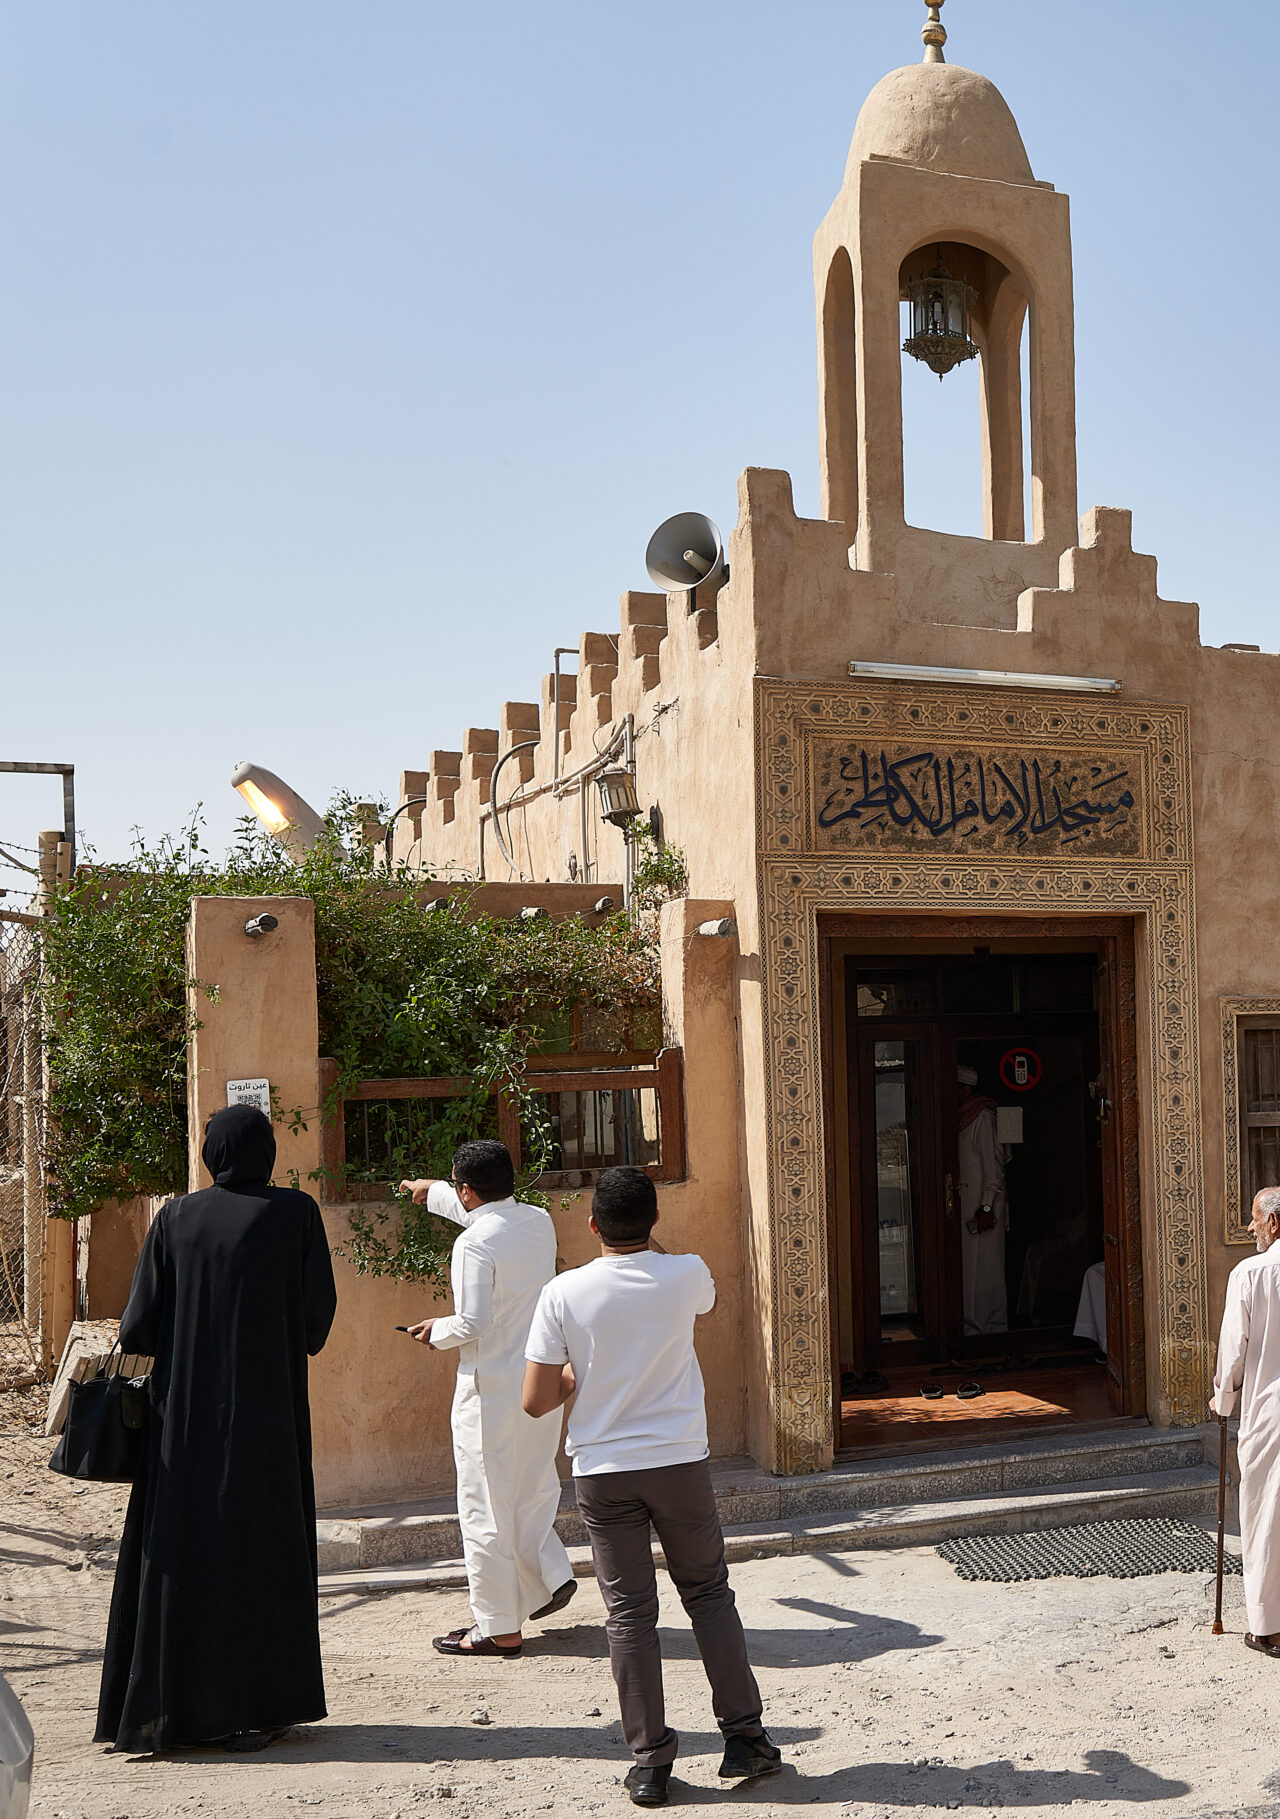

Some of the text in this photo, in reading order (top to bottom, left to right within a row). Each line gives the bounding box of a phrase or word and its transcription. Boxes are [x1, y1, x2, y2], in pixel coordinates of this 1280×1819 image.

[1031, 760, 1135, 844] مسجد
[229, 1082, 268, 1091] عين تاروت
